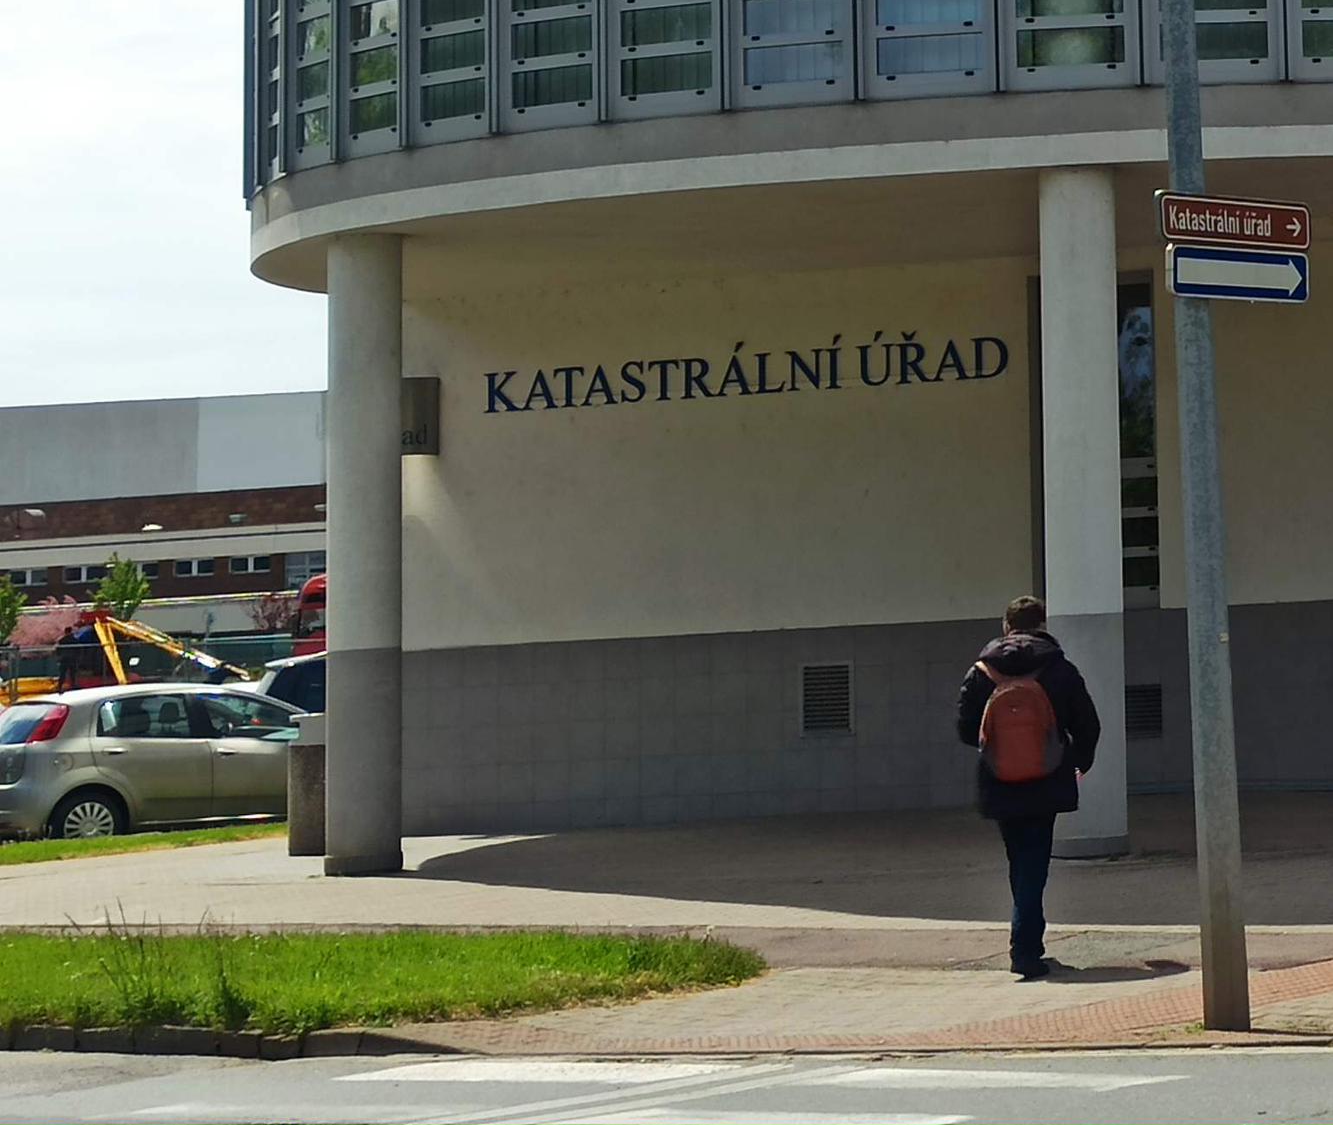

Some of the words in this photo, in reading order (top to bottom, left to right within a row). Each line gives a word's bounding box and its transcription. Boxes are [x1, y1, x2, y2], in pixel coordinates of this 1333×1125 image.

[1168, 204, 1240, 235] Katastrální
[1243, 210, 1272, 237] úřad
[483, 333, 842, 414] KATASTRÁLNÍ
[856, 330, 1009, 386] ÚŘAD
[401, 423, 428, 445] ad
